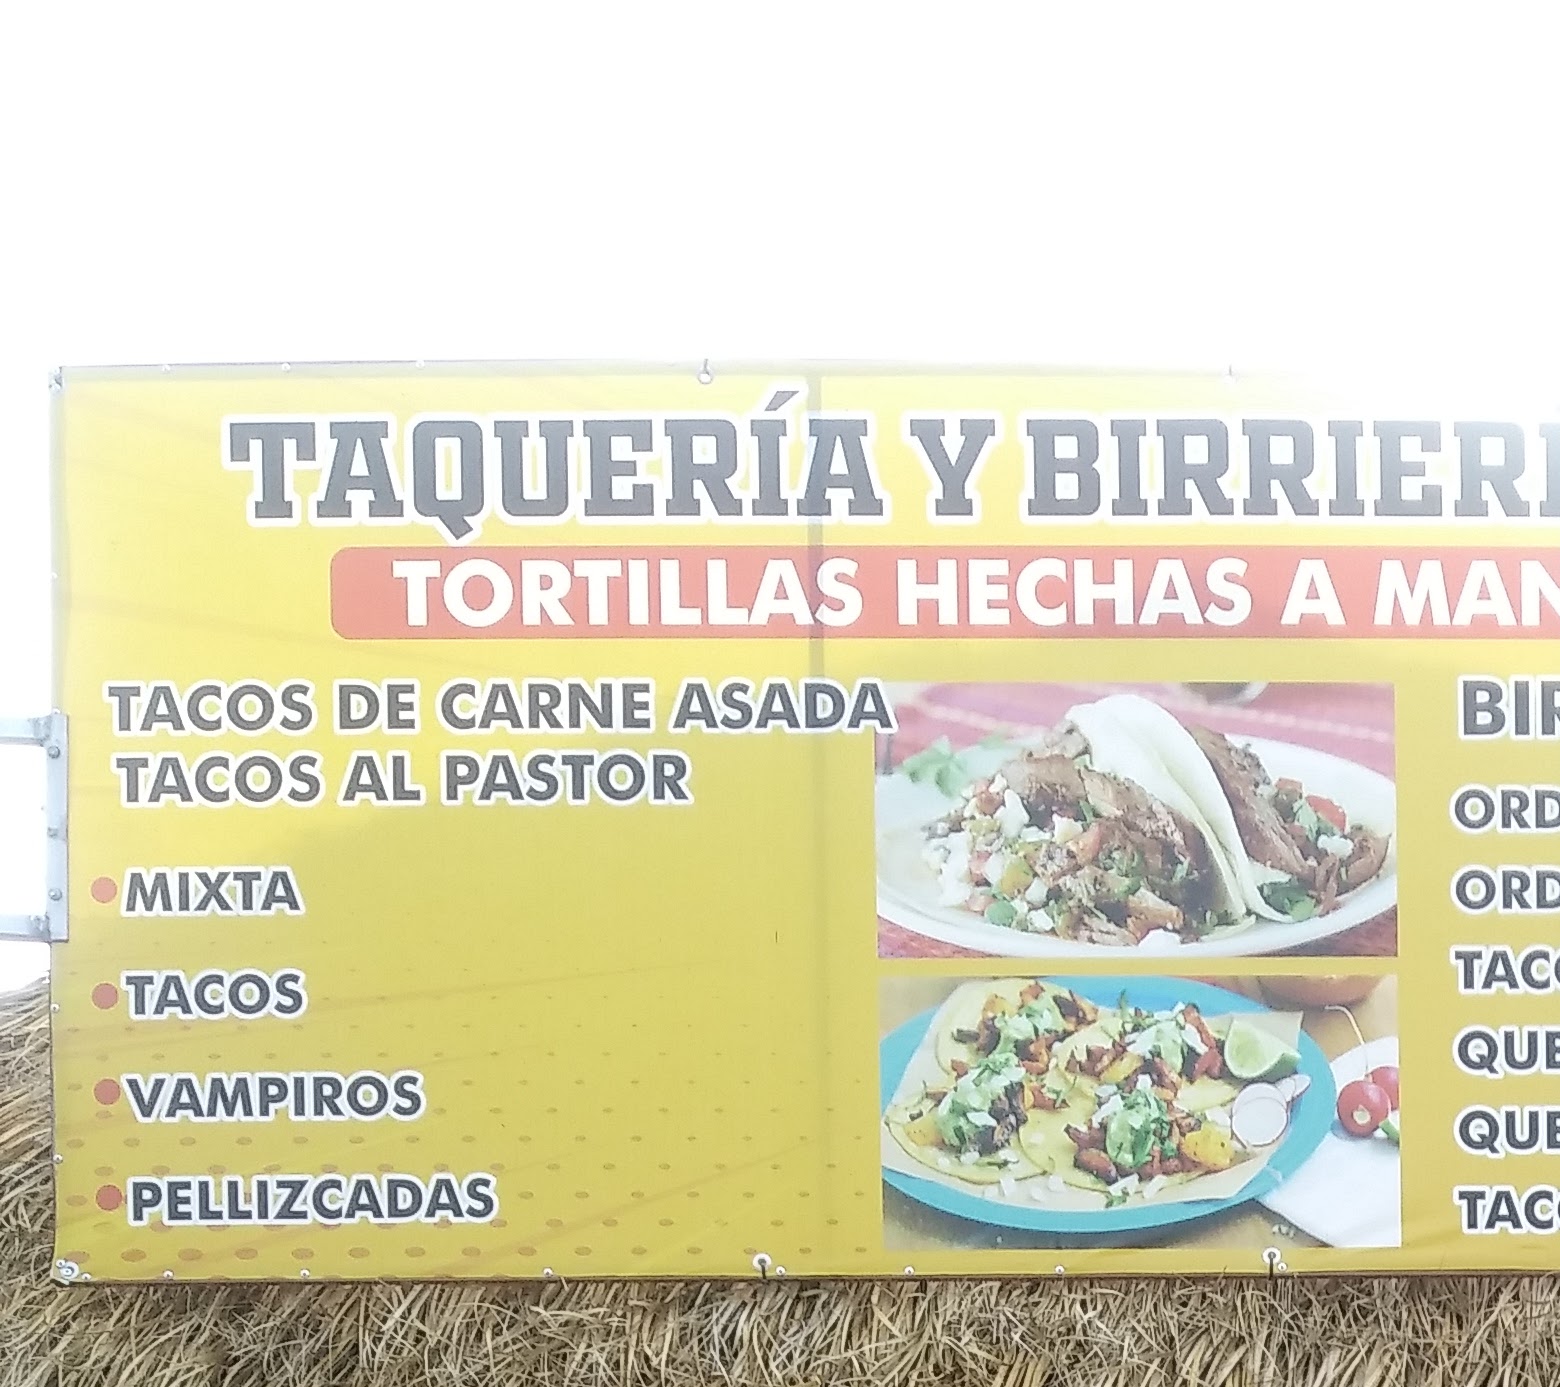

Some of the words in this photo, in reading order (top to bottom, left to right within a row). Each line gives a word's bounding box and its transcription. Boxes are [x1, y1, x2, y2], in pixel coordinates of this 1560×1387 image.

[229, 389, 884, 540] TAQUERÍA
[911, 419, 995, 516] Y
[392, 557, 864, 628] TORTILLAS
[896, 557, 1252, 629] HECHAS
[1280, 558, 1346, 626] A
[107, 684, 313, 734] TACOS
[339, 684, 415, 731] DE
[441, 682, 651, 731] CARNE
[673, 682, 893, 731] ASADA
[114, 756, 320, 804] TACOS
[343, 755, 420, 802] AL
[446, 753, 690, 802] PASTOR
[125, 871, 302, 913] MIXTA
[125, 973, 305, 1018] TACOS
[125, 1074, 422, 1119] VAMPIROS
[132, 1178, 495, 1223] PELLIZCADAS
